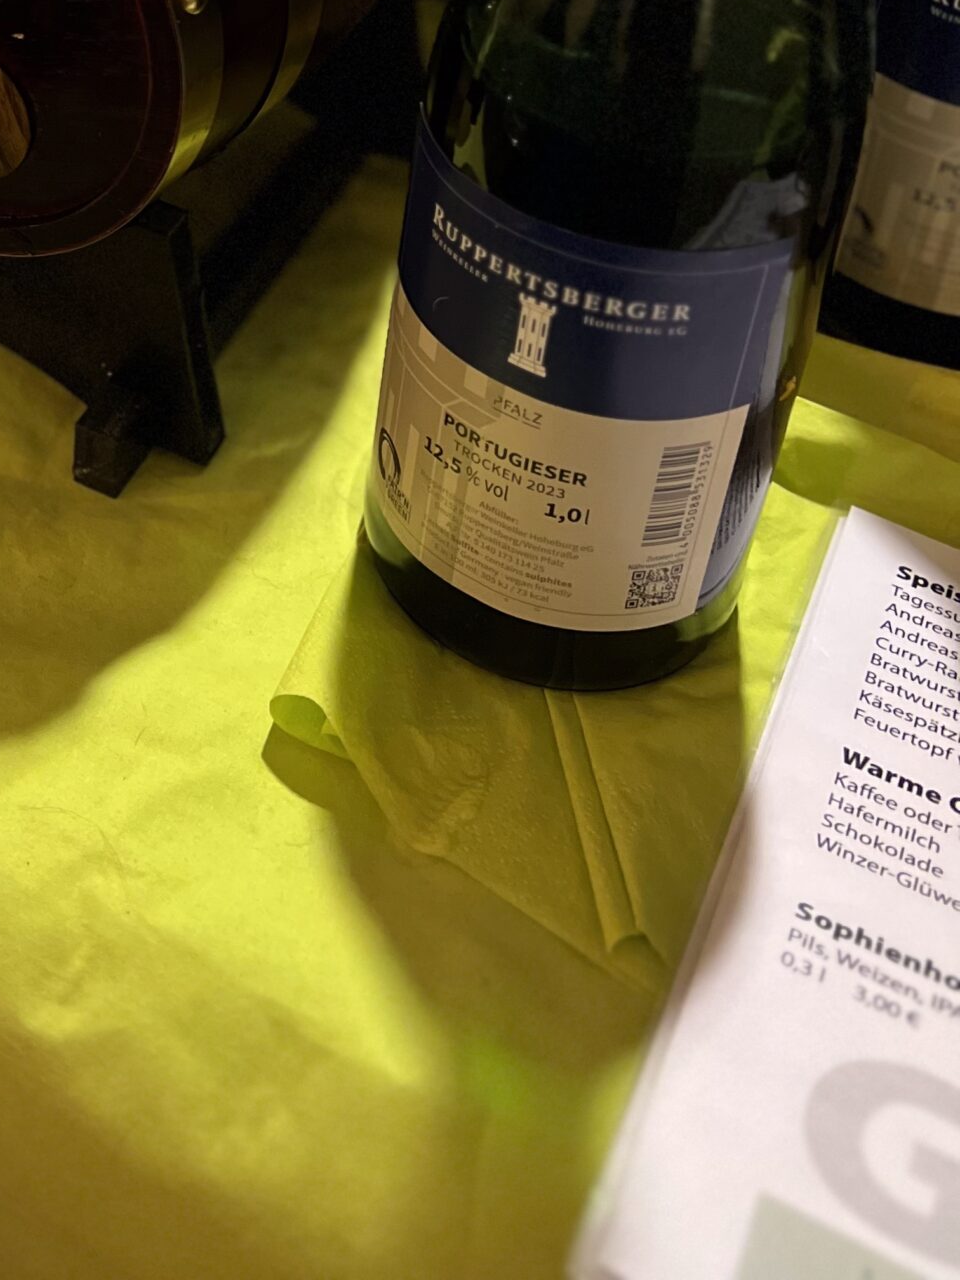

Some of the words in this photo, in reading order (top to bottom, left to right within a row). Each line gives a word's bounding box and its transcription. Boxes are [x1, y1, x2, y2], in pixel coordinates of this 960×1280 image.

[423, 435, 463, 475] 12,5
[465, 465, 481, 487] %
[483, 478, 510, 502] vol
[443, 412, 589, 488] PORTUGIESER
[453, 438, 523, 486] TROCKEN
[526, 478, 566, 500] 2023
[879, 619, 959, 661] Andreas
[865, 670, 960, 722] Bratwurst
[854, 707, 955, 761] Feuertopf
[834, 771, 899, 812] Kaffee
[903, 806, 953, 834] oder
[843, 746, 942, 806] Warme
[821, 813, 944, 879] Schokolade
[828, 792, 941, 855] Hafermilch
[787, 927, 829, 961] Pils,
[794, 902, 960, 991] Sophienho
[780, 951, 814, 977] 0,3
[852, 984, 902, 1019] 3,00
